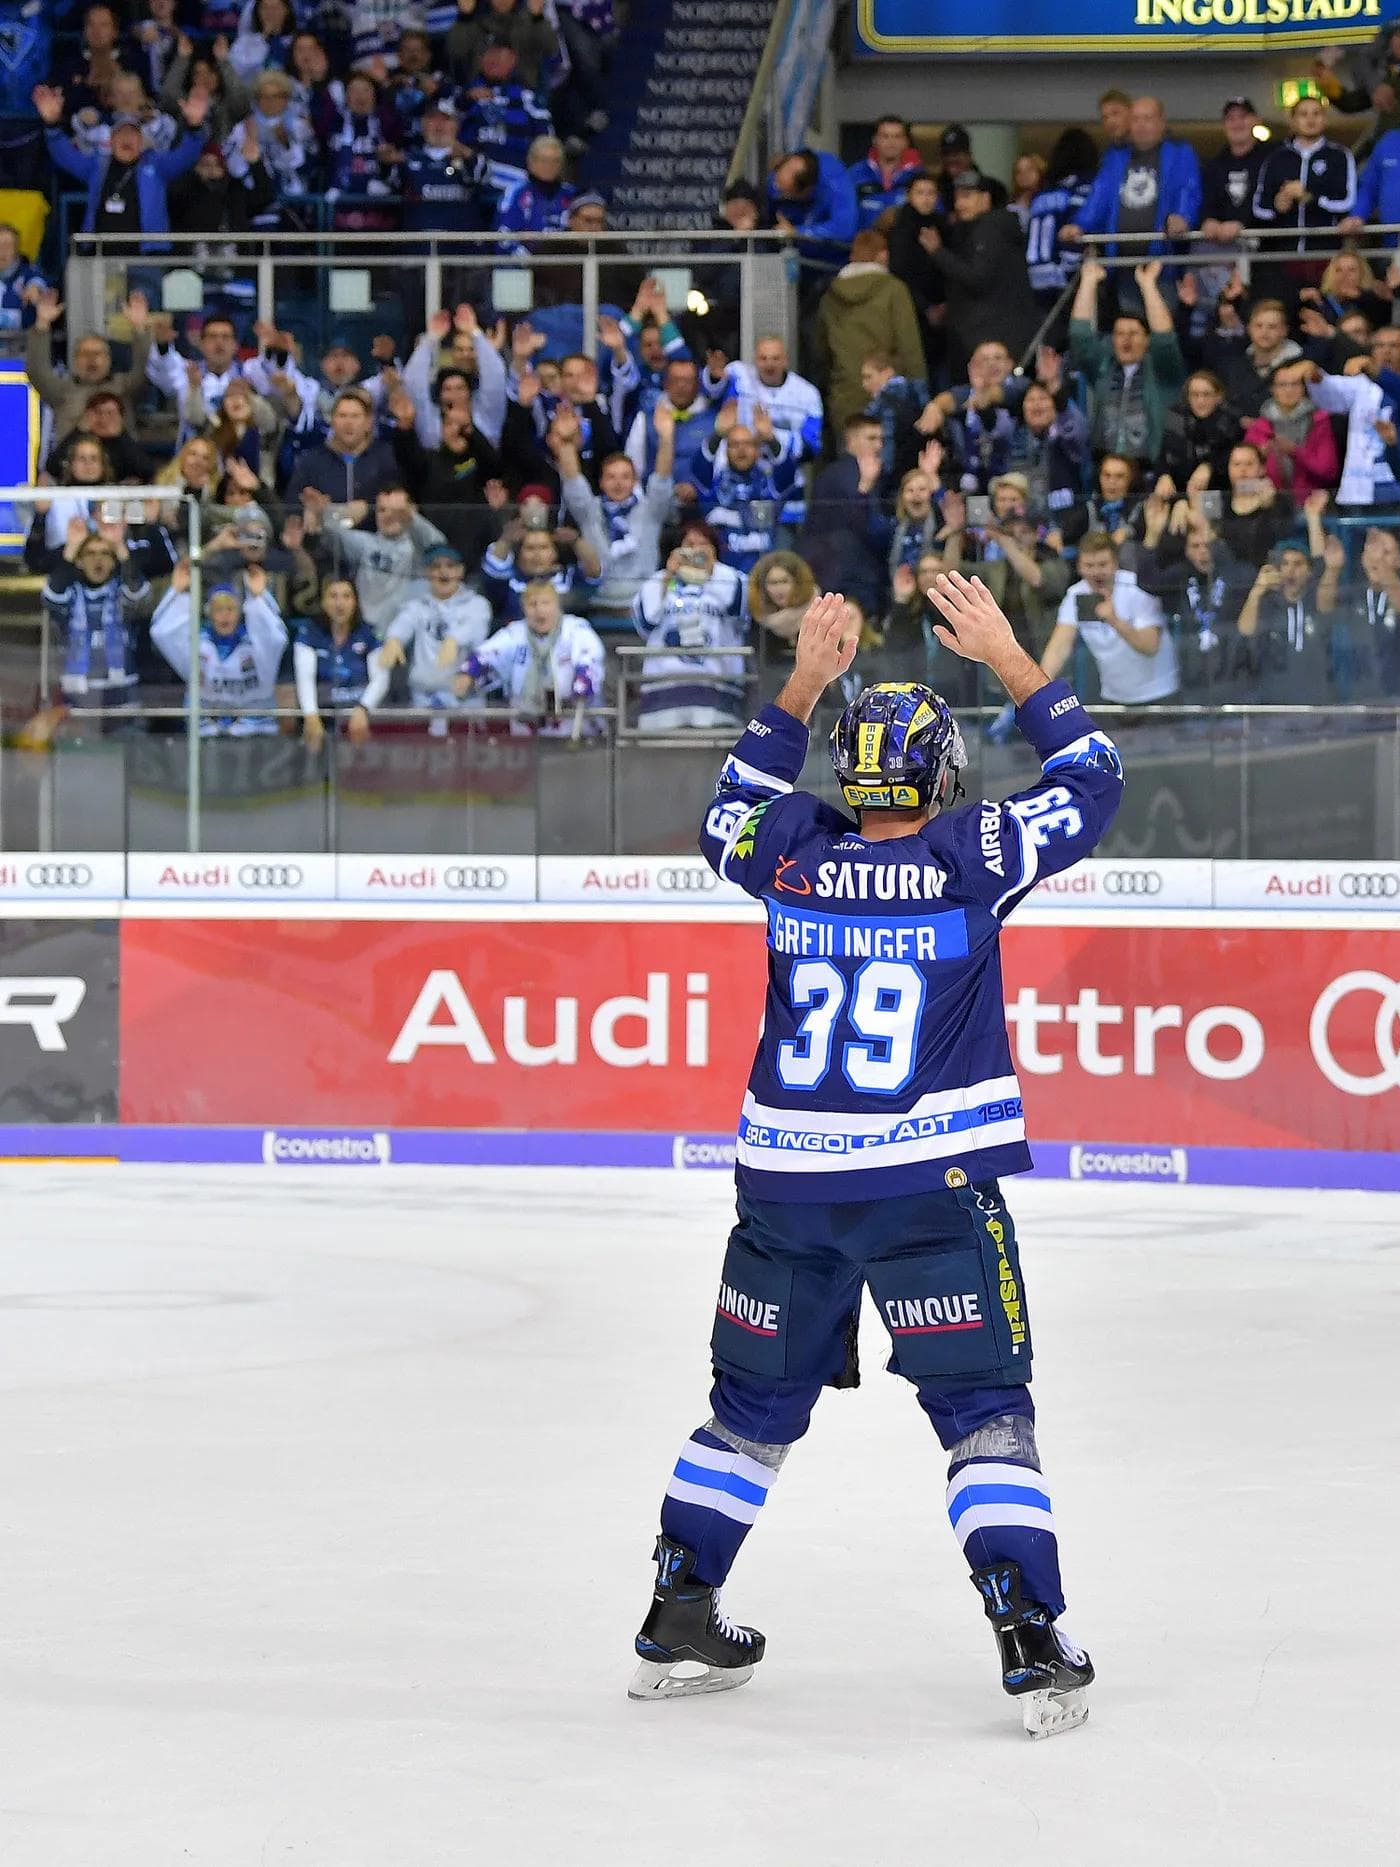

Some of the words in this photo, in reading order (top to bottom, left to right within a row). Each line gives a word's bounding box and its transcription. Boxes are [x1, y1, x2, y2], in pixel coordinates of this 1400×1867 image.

[159, 865, 230, 887] Audi
[367, 866, 437, 888] Audi
[583, 869, 650, 890] Audi
[815, 861, 947, 900] SATURN
[1264, 873, 1331, 897] Audi
[387, 969, 709, 1068] Audi
[776, 956, 928, 1095] 39
[718, 1283, 781, 1330] INQUE
[885, 1292, 983, 1327] CINQUE
